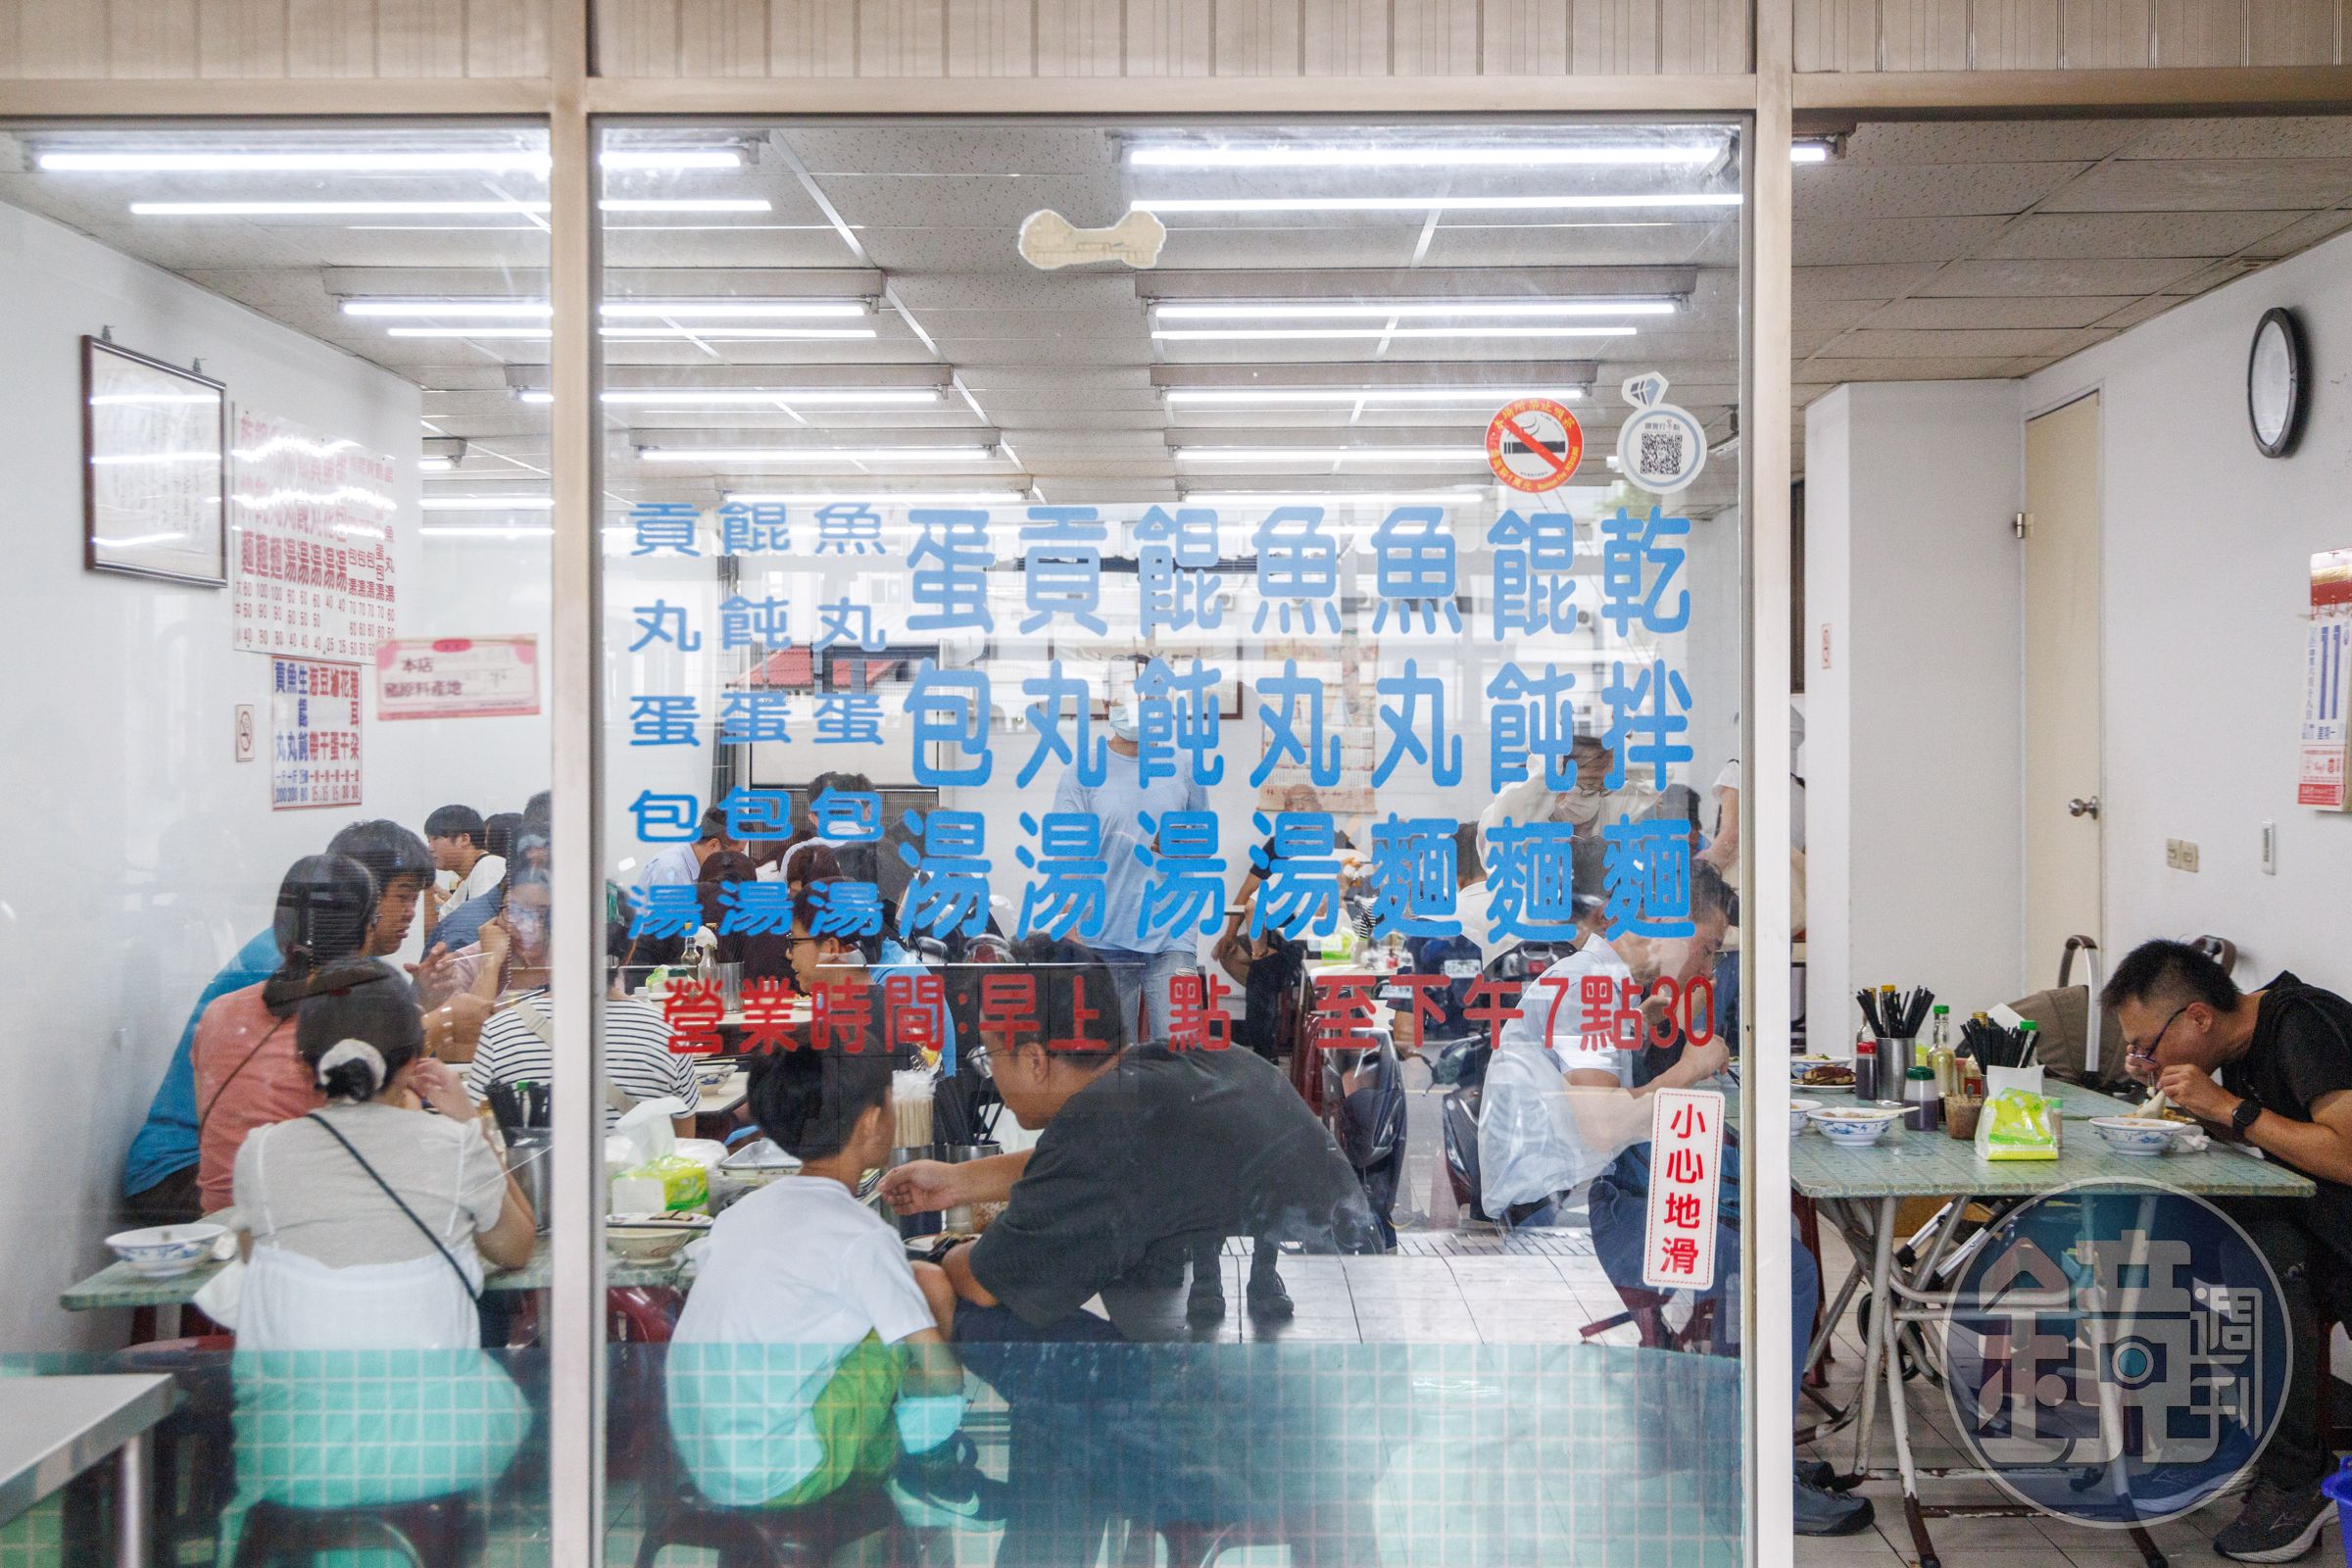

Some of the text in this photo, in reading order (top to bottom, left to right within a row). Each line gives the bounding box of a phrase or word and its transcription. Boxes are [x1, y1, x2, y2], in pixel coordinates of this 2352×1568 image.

[287, 662, 298, 761] 魚丸
[319, 666, 329, 760] 豆干
[340, 668, 350, 760] 花干
[401, 657, 433, 673] 本店
[627, 503, 703, 939] 貢丸蛋包湯
[718, 503, 794, 938] 餛飩蛋包湯
[808, 503, 885, 938] 魚丸蛋包湯
[899, 509, 995, 941] 蛋包湯
[1015, 506, 1108, 941] 貢丸湯
[1133, 505, 1227, 941] 餛飩湯
[1249, 505, 1342, 941] 魚丸湯
[1370, 505, 1463, 940] 魚丸麵
[1485, 508, 1579, 945] 餛飩麵
[1600, 505, 1695, 941] 乾拌麵
[1315, 974, 1714, 1052] 至下午7點30
[1660, 1103, 1706, 1275] 小心地滑
